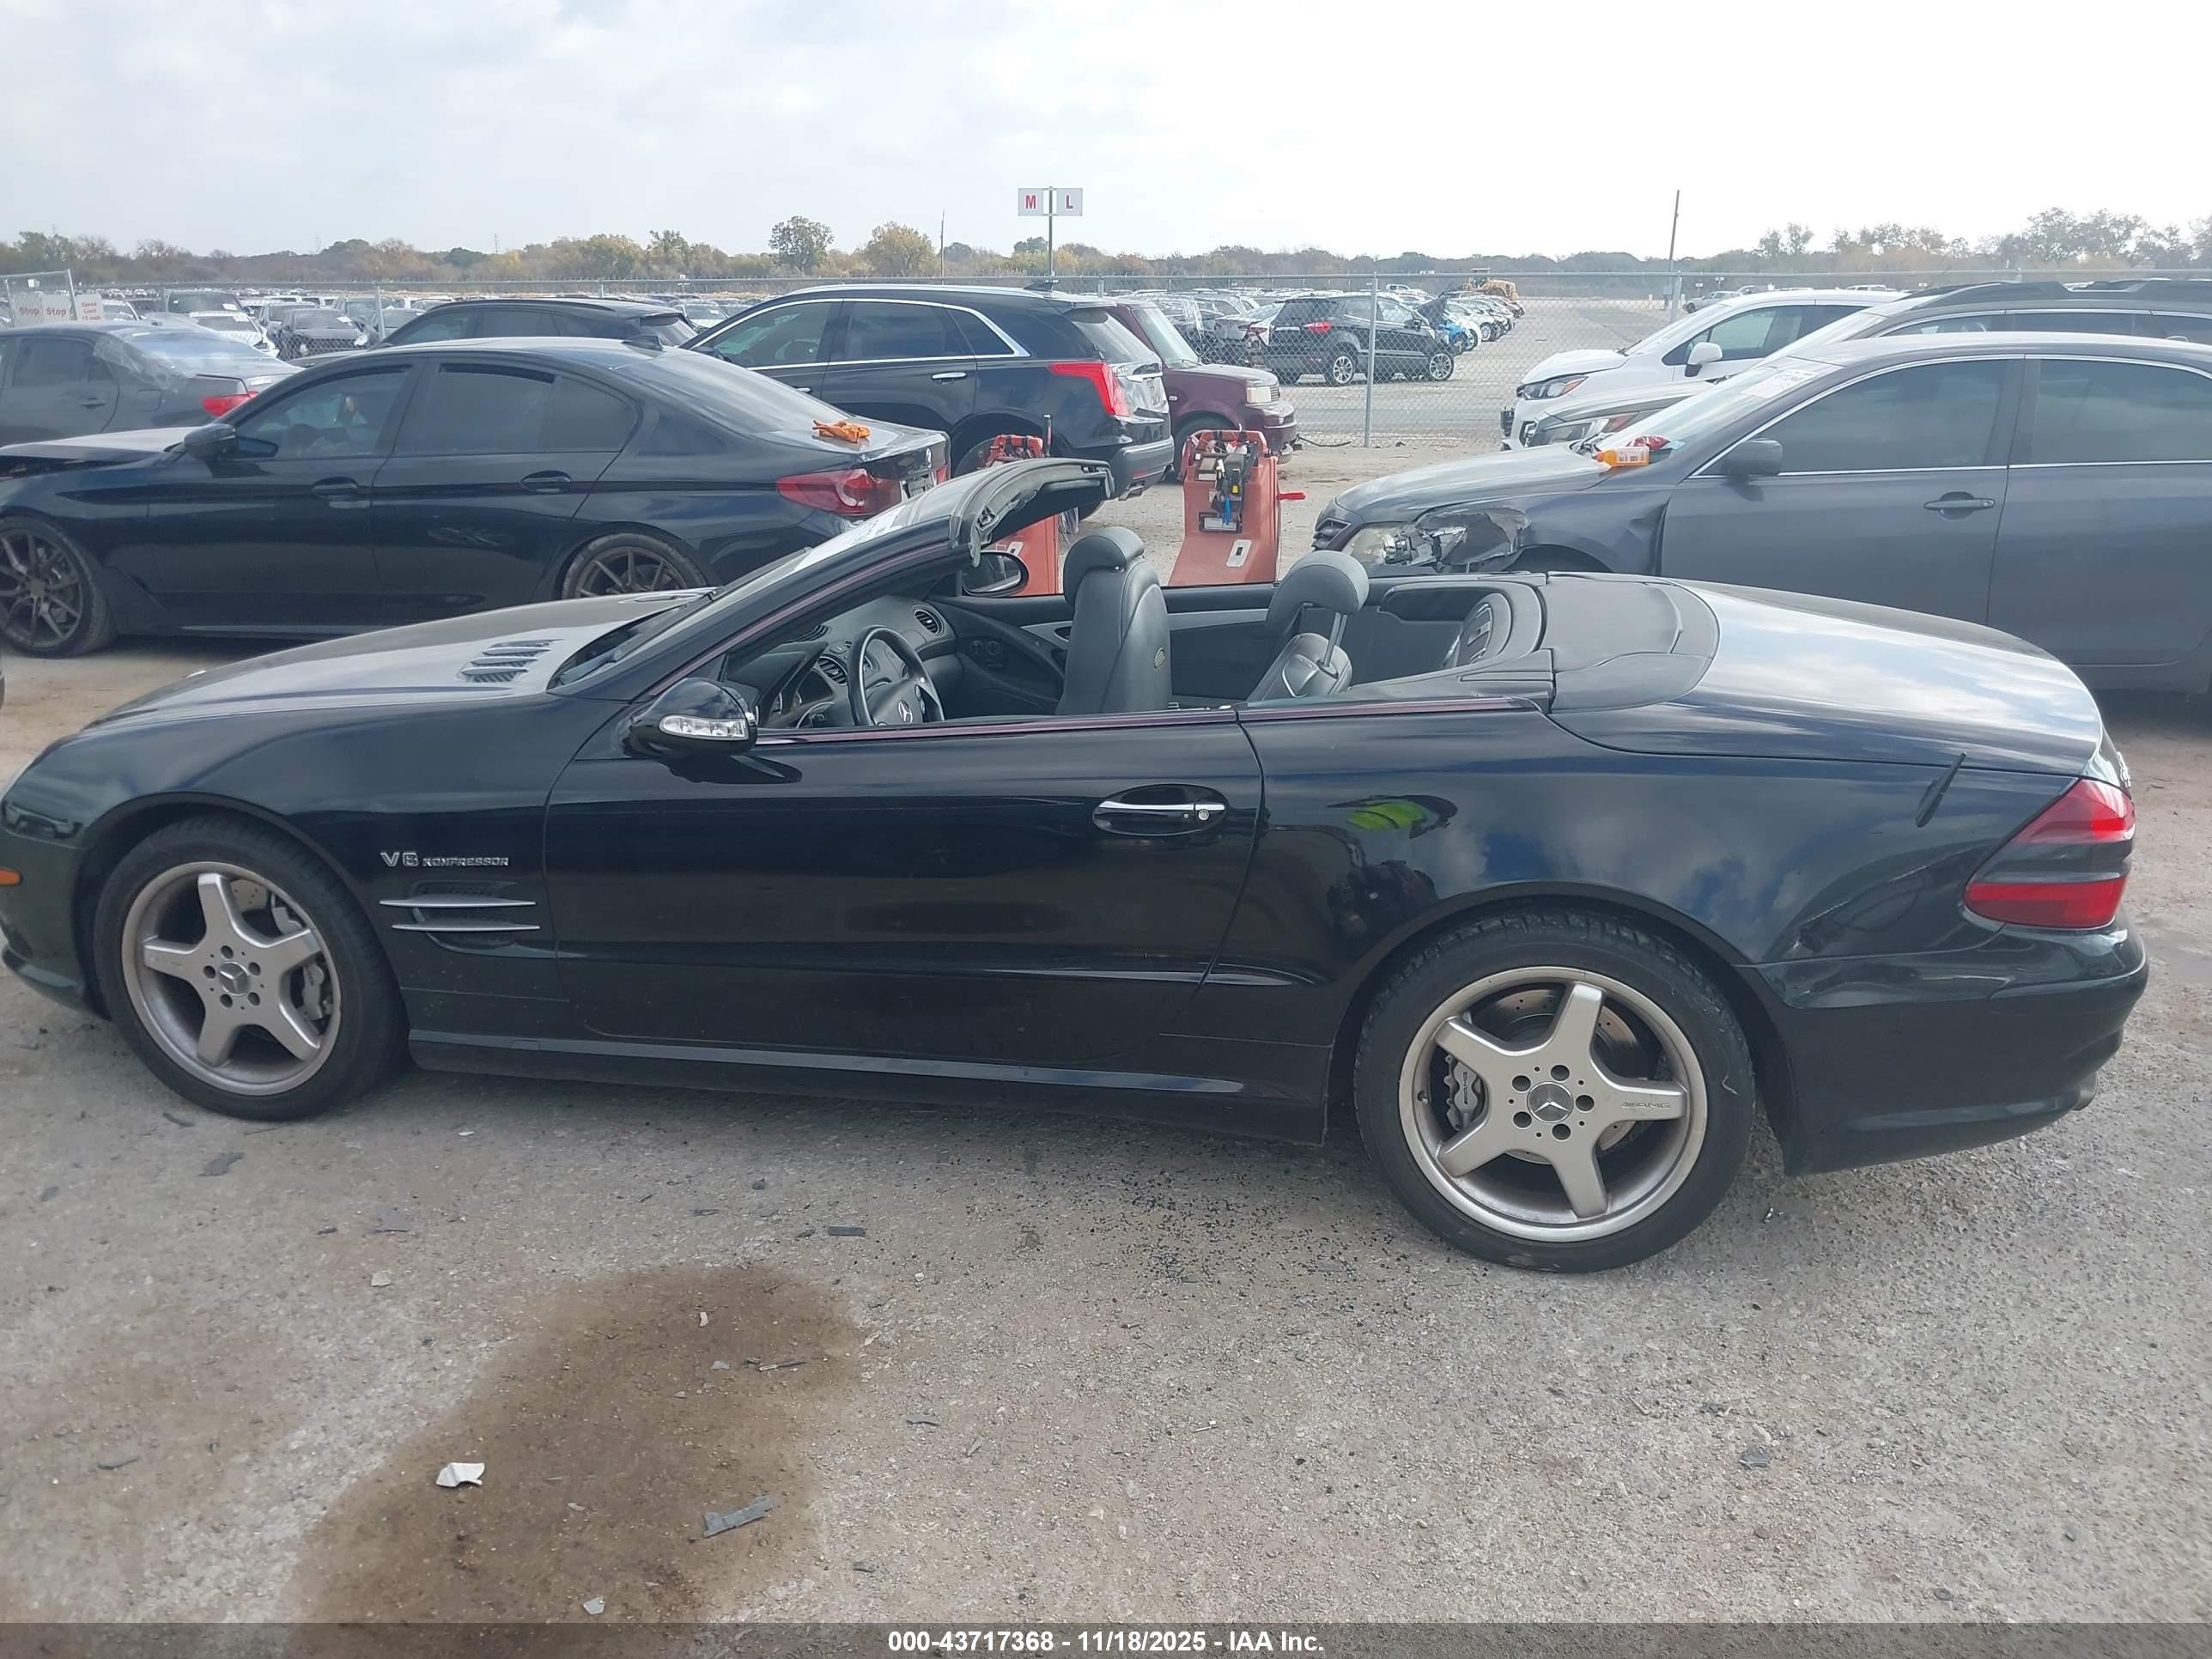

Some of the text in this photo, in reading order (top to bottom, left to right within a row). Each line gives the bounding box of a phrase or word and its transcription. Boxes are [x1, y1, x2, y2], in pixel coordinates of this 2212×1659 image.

[1025, 195, 1036, 210] M
[1066, 195, 1073, 210] L
[46, 307, 67, 316] Stop
